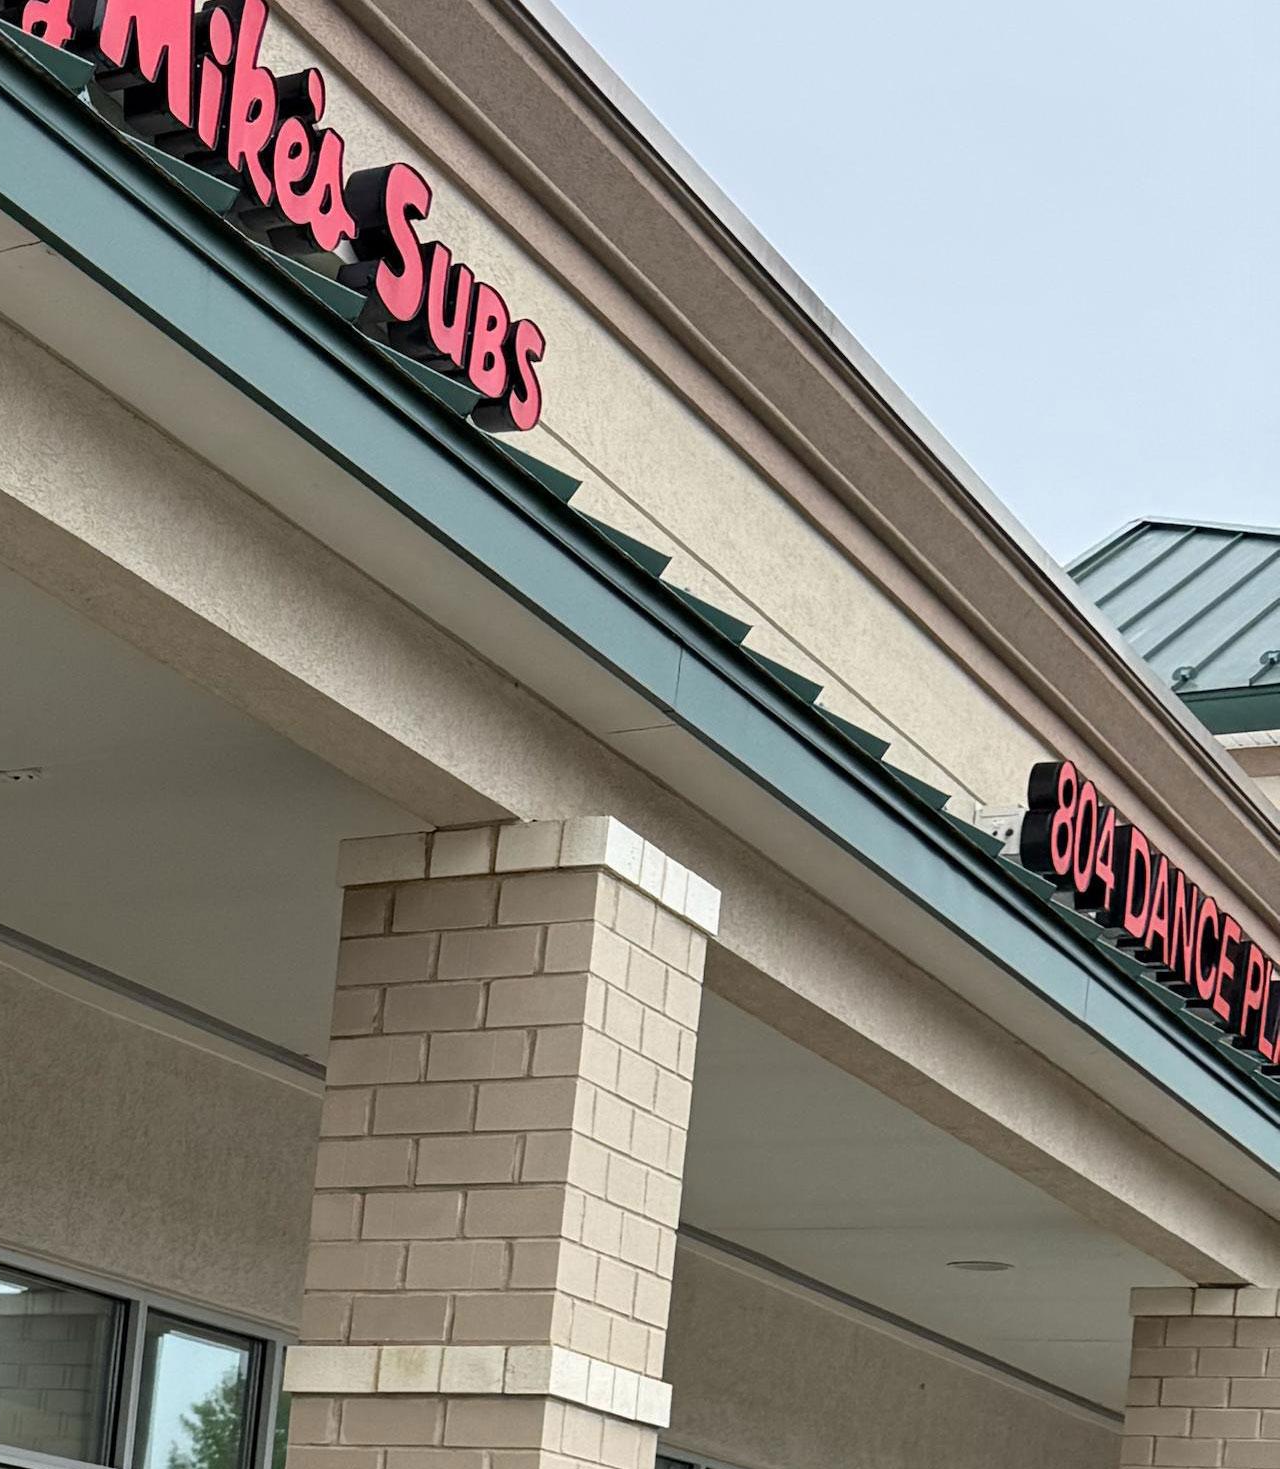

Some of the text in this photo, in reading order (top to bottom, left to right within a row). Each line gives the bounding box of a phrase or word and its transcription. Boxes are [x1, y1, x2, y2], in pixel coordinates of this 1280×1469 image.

[375, 162, 545, 432] SUBS
[1051, 760, 1280, 1065] 804 DANCE PL
